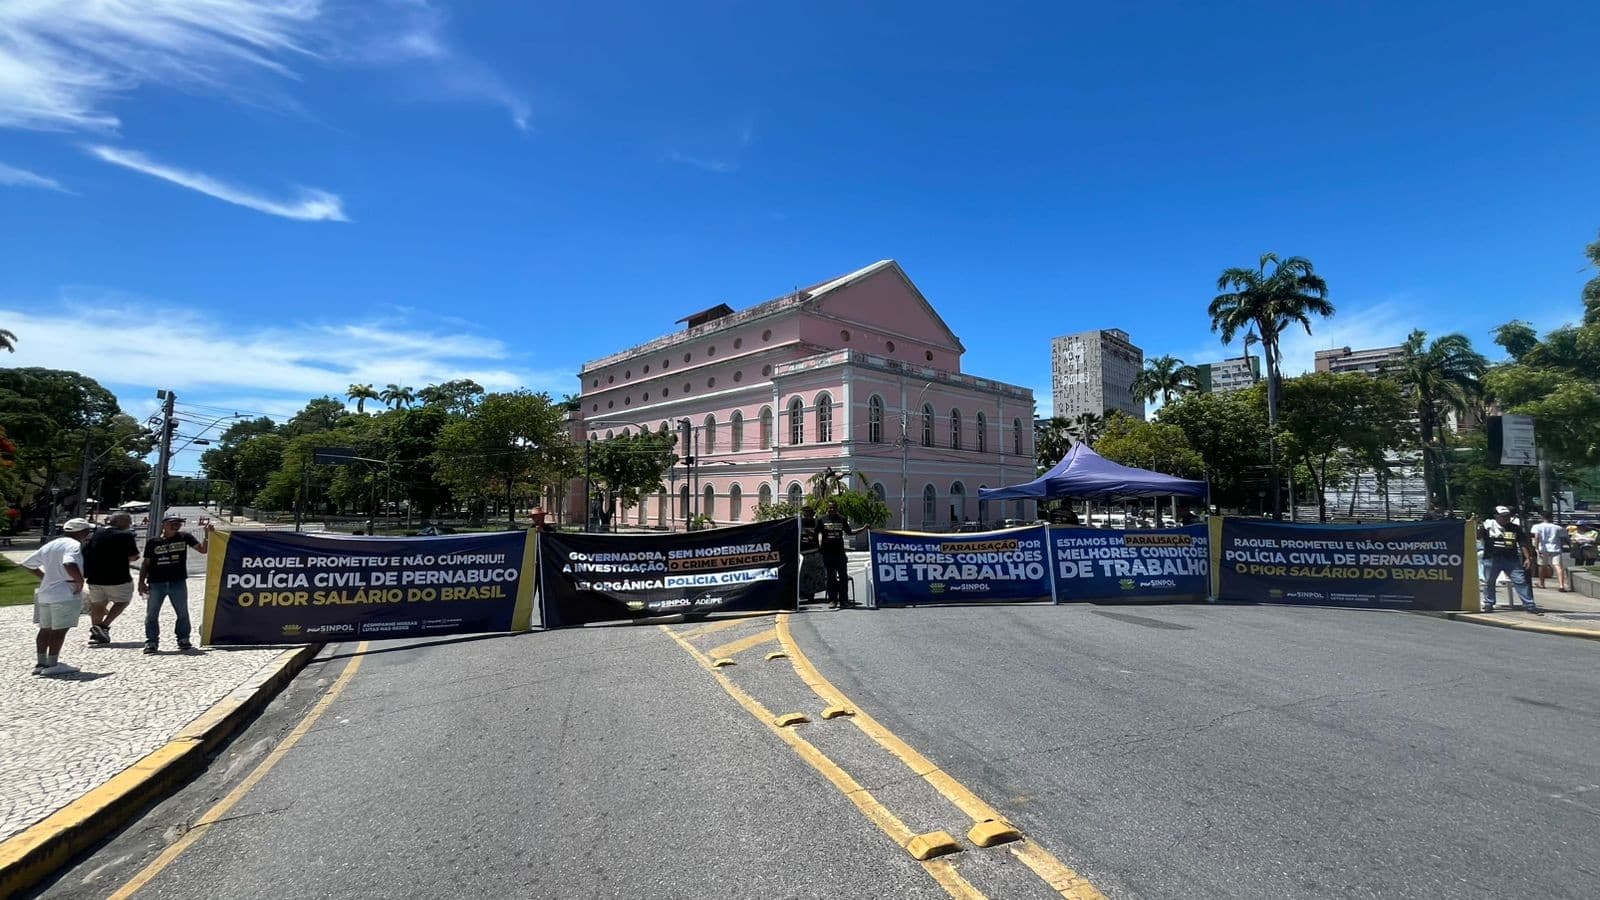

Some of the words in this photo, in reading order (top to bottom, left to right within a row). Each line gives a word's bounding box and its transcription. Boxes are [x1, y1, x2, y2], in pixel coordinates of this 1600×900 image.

[876, 542, 925, 551] ESTAMOS
[942, 541, 1017, 552] PARALISAÇÃO
[1018, 540, 1040, 549] POR
[1057, 538, 1105, 547] ESTAMOS
[1109, 537, 1124, 545] EM
[1126, 536, 1191, 545] PARALISAÇÃO
[1234, 538, 1279, 548] RAQUEL
[1281, 539, 1344, 550] PROMETEU
[1346, 541, 1355, 549] E
[1357, 540, 1384, 550] NÃO
[1387, 541, 1447, 550] CUMPRIU!!
[569, 551, 666, 562] GOVERNADORA,
[668, 550, 693, 559] SEM
[695, 543, 771, 558] MODERNIZAR
[877, 553, 954, 563] MELHORES
[957, 549, 1042, 564] CONDIÇÕES
[1058, 548, 1138, 560] MELHORES
[1141, 546, 1208, 559] CONDIÇÕES
[1225, 549, 1287, 563] POLÍCIA
[1289, 553, 1331, 564] CIVIL
[1333, 554, 1356, 565] DE
[241, 557, 305, 568] RAQUEL
[307, 556, 388, 568] PROMETEU
[391, 556, 400, 566] E
[403, 554, 435, 566] NÃO
[438, 554, 505, 565] CUMPRIU!!
[562, 563, 572, 573] A
[574, 561, 667, 573] INVESTIGAÇÃO,
[670, 562, 679, 570] O
[682, 559, 718, 569] CRIME
[878, 565, 908, 582] DE
[912, 562, 1044, 581] TRABALHO
[1059, 561, 1094, 578] DE
[1098, 559, 1208, 577] TRABALHO
[1236, 563, 1247, 573] O
[1250, 564, 1286, 576] PIOR
[1289, 565, 1360, 577] SALÁRIO
[1363, 568, 1387, 579] DO
[1392, 568, 1453, 580] BRASIL
[227, 570, 309, 589] POLÍCIA
[313, 572, 366, 587] CIVIL
[370, 571, 398, 586] DE
[593, 579, 663, 591] ORGÂNICA
[667, 574, 718, 586] POLÍCIA
[961, 583, 990, 591] SINPOL
[238, 592, 254, 607] O
[258, 591, 309, 606] PIOR
[312, 587, 403, 606] SALÁRIO
[407, 588, 437, 602] DO
[440, 585, 506, 601] BRASIL
[661, 598, 691, 607] SINPOL
[320, 624, 354, 632] SINPOL
